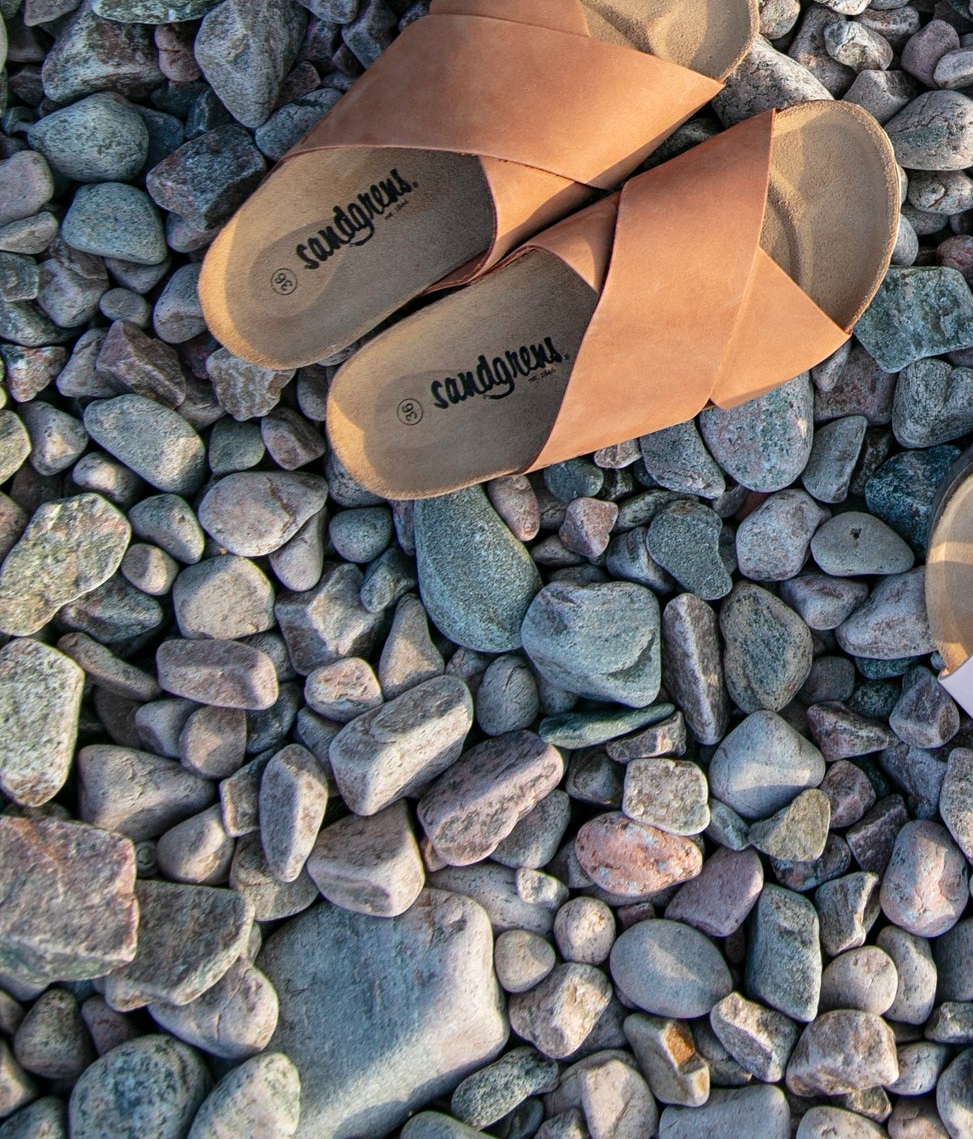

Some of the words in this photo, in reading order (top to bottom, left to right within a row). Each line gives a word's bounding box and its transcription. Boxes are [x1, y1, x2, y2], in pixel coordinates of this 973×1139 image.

[296, 168, 412, 270] sandgrens
[274, 273, 293, 291] 36
[431, 337, 563, 409] sandgrens
[402, 403, 417, 421] 36
